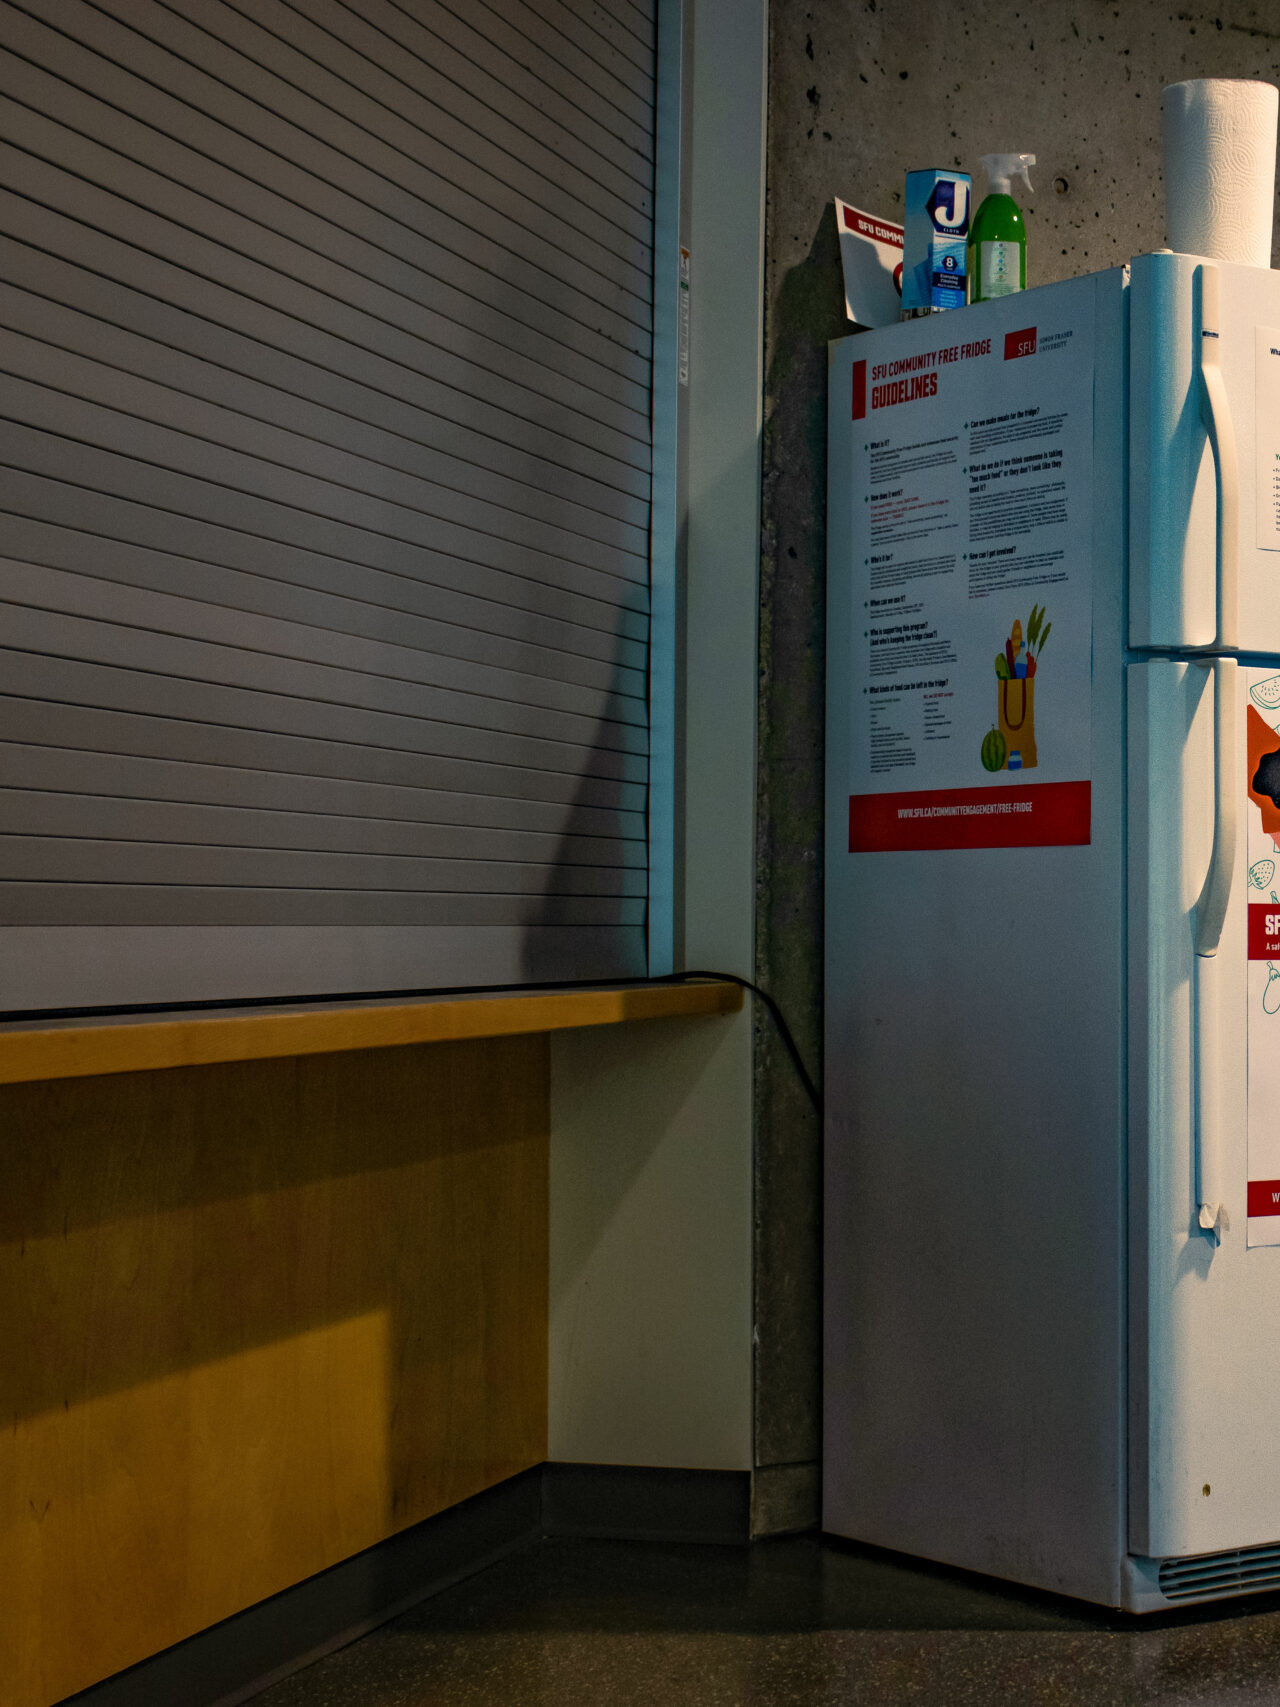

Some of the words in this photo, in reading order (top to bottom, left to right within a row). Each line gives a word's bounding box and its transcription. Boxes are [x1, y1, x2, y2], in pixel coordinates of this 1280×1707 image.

[935, 181, 967, 228] J
[858, 219, 874, 234] SFU
[946, 258, 953, 266] 8
[872, 364, 887, 380] SFU
[889, 352, 936, 376] COMMUNITY
[939, 347, 958, 364] FREE
[961, 339, 991, 360] FRIDGE
[1018, 340, 1035, 356] SFU
[872, 372, 937, 410] GUIDELINES
[970, 464, 980, 473] What
[1011, 456, 1022, 464] think
[1024, 454, 1042, 463] someone
[1049, 449, 1062, 458] taking
